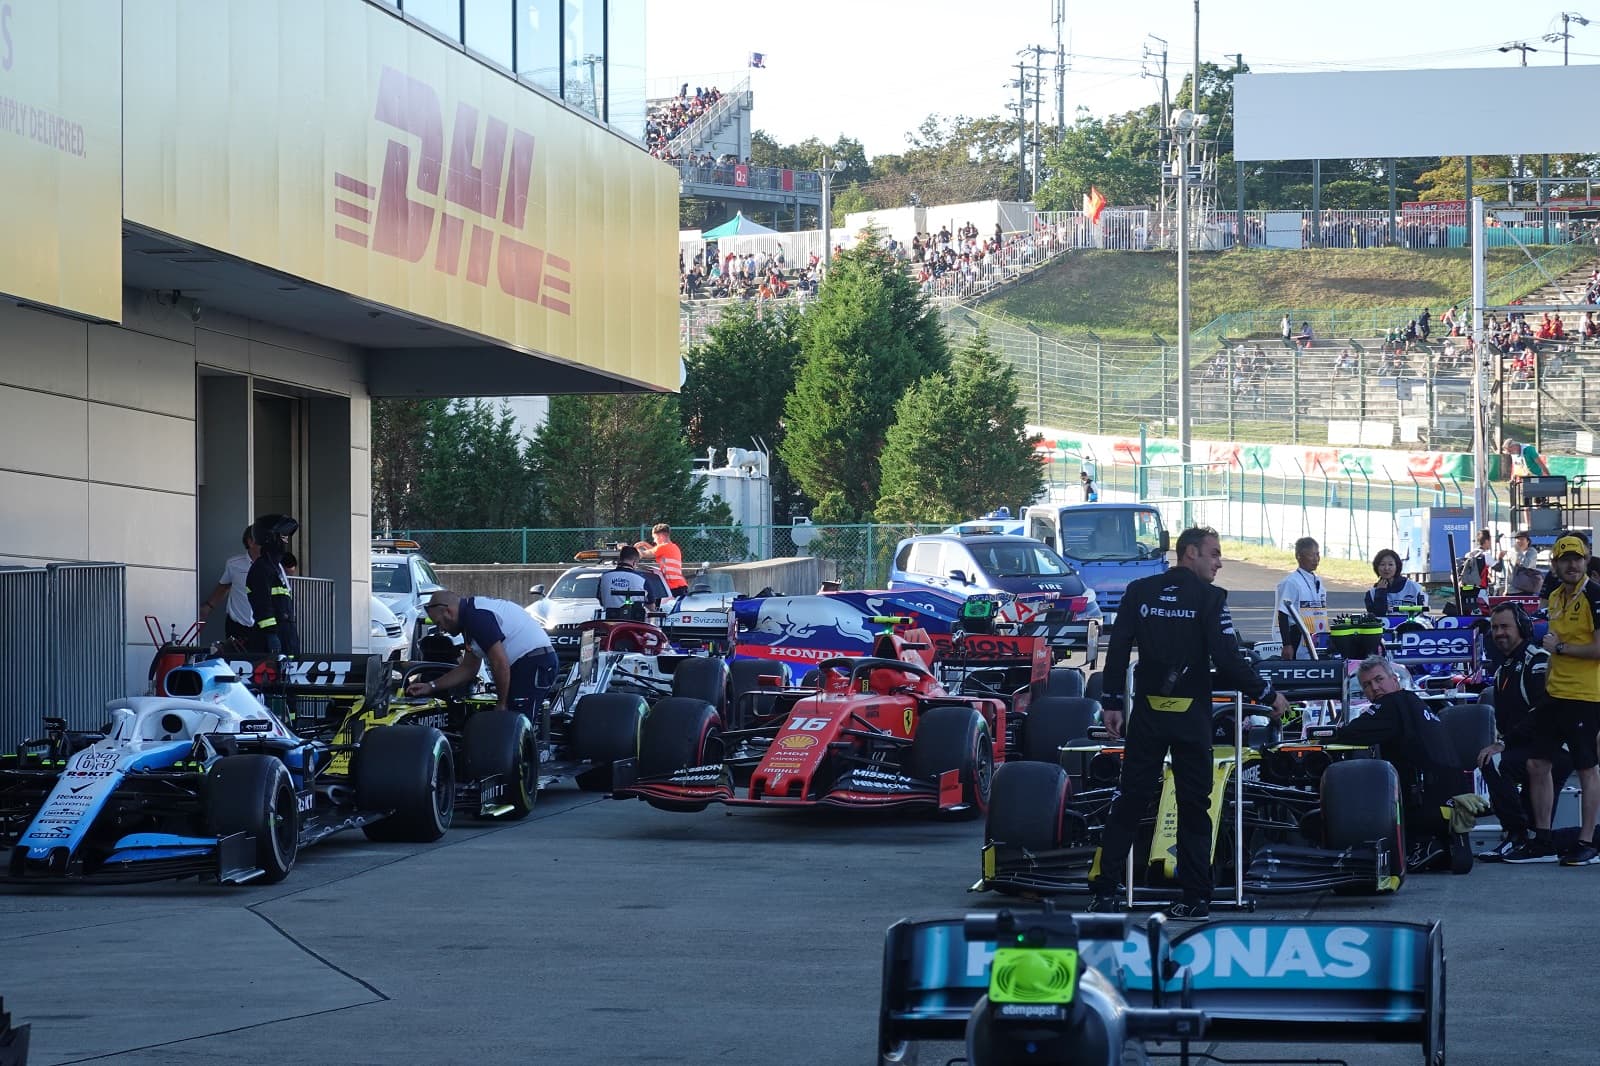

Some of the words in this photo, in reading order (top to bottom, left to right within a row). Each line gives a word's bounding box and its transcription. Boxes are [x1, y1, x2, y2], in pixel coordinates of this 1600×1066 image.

[30, 105, 87, 159] DELIVERED.
[372, 64, 545, 304] DHL
[693, 616, 728, 624] Svizzera
[1151, 608, 1197, 618] RENAULT
[770, 647, 844, 660] HONDA
[1259, 669, 1335, 680] E-TECH
[418, 713, 449, 727] MAPFRE
[787, 717, 832, 731] 16
[75, 753, 121, 770] 63
[852, 768, 912, 782] MISSION
[966, 927, 1371, 977] PRONAS
[1002, 1004, 1057, 1017] ebmpapst
